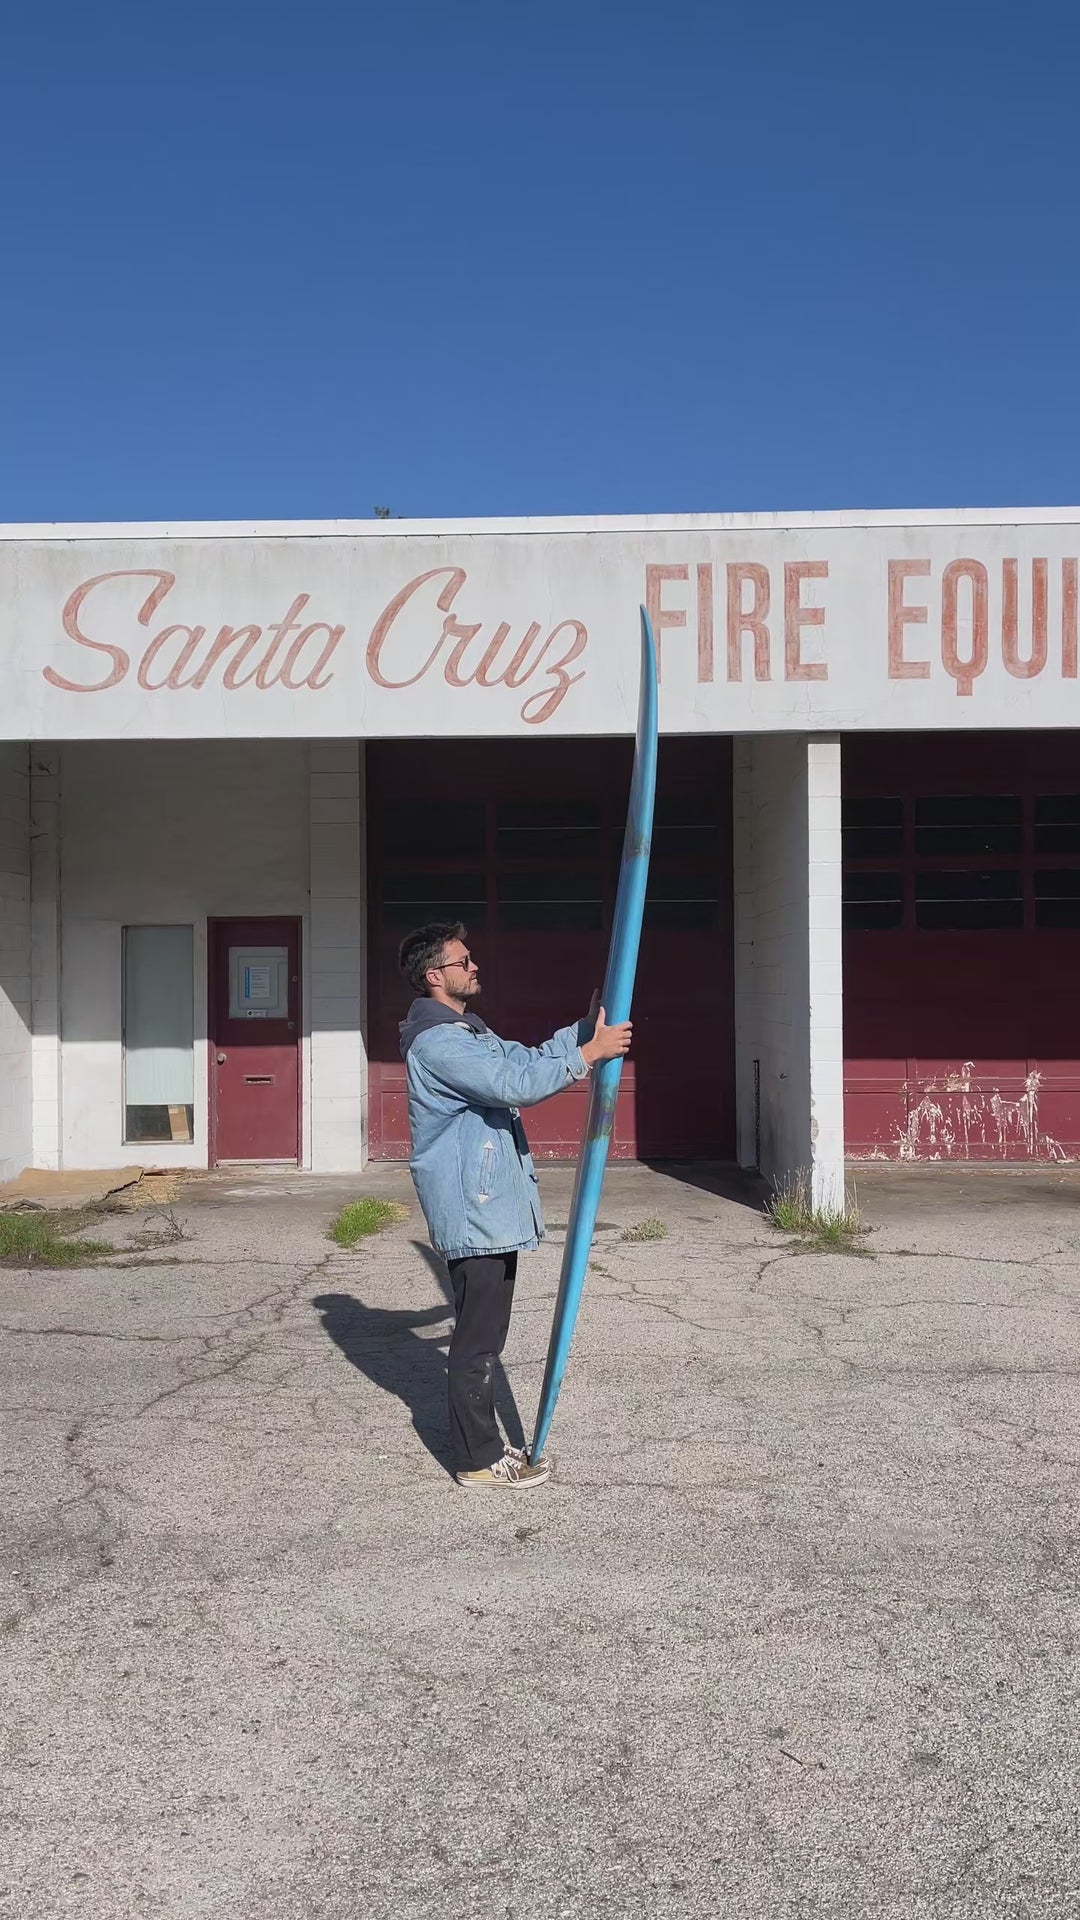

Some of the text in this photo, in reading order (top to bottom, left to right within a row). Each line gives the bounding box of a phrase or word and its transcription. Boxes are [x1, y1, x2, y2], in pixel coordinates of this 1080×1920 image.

[43, 557, 1078, 724] Santa Cruz FIRE EQUI
